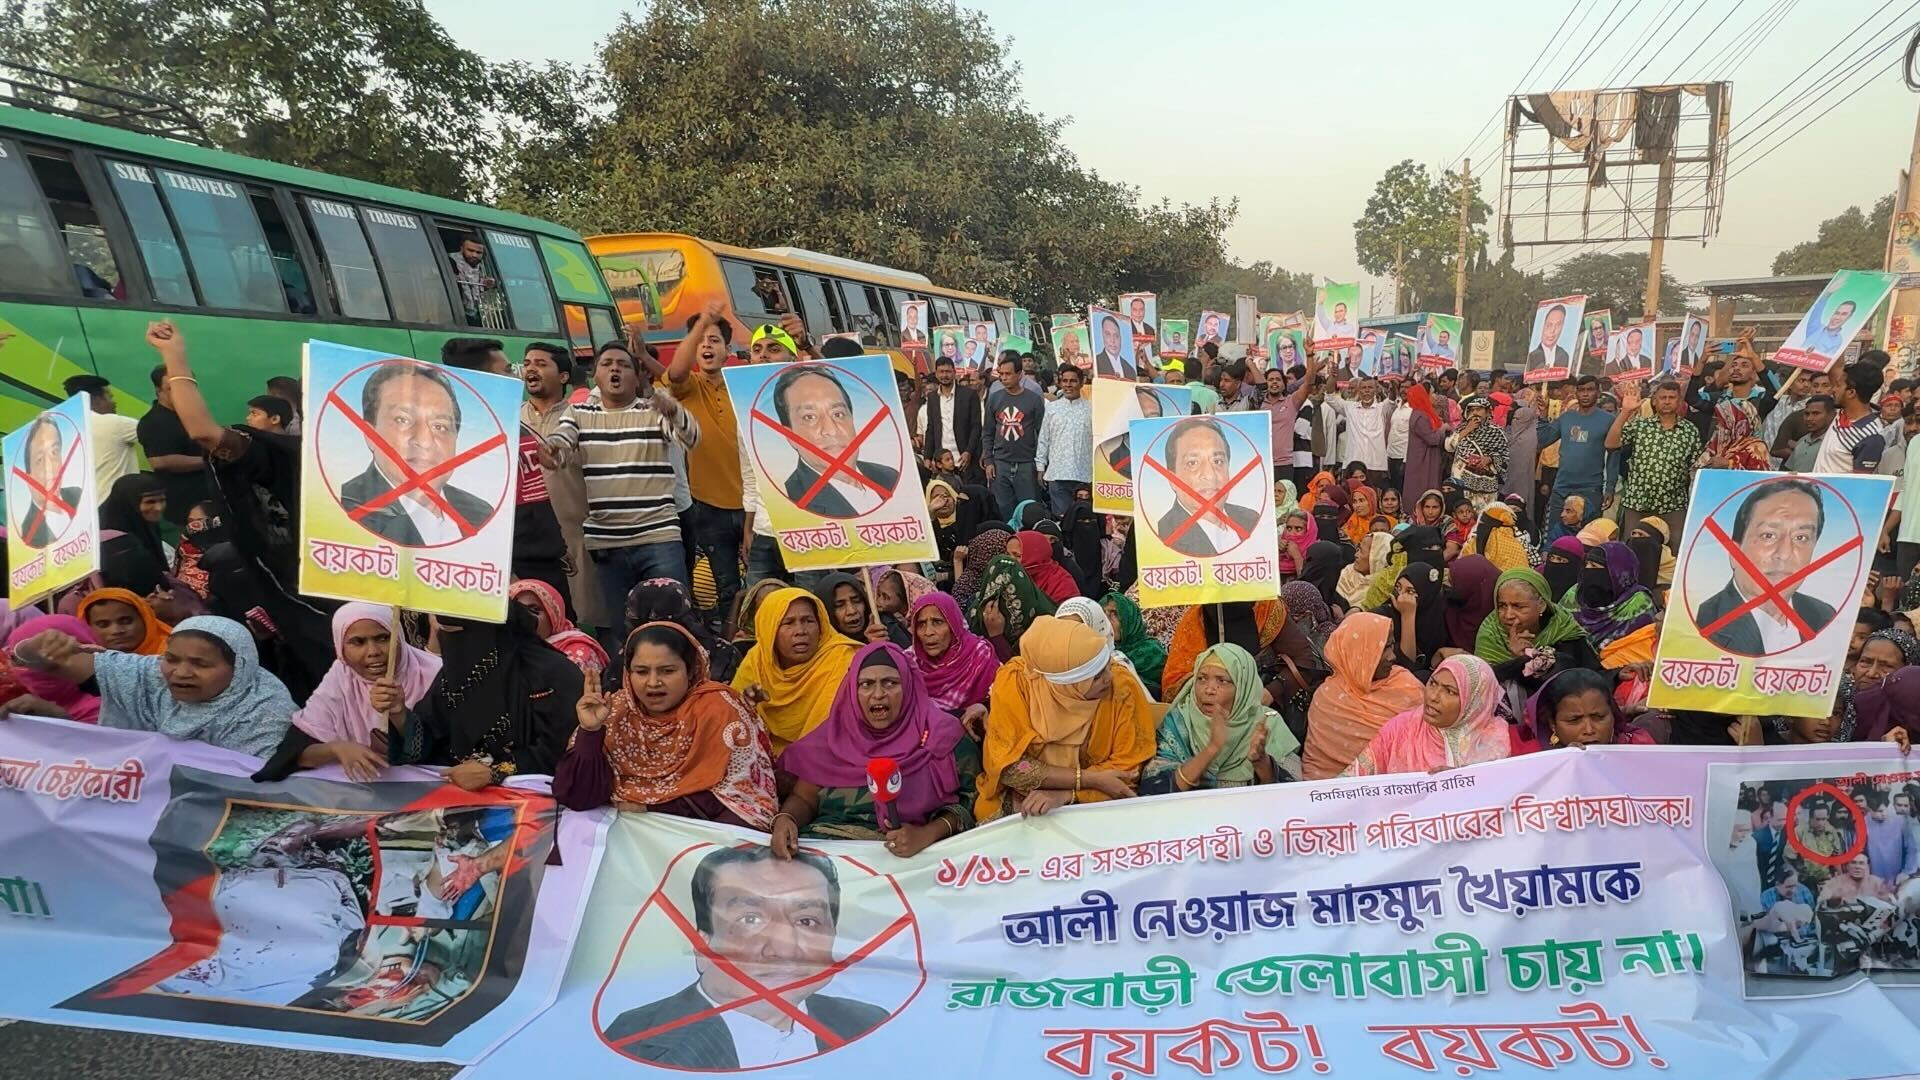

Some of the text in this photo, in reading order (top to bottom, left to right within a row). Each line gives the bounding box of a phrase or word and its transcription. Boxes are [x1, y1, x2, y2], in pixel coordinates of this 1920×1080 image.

[165, 172, 238, 199] TRAVELS
[366, 208, 417, 230] TRAVELS
[492, 232, 531, 249] TRAVELS
[52, 530, 91, 566] বয়কট!
[780, 516, 925, 551] বয়কট! বয়কট!
[311, 541, 502, 594] বয়কট! বয়কট!
[1142, 557, 1272, 589] বয়কট! বয়কট!
[1661, 657, 1832, 694] বয়কট! বয়কট!
[37, 758, 146, 800] চেষ্টাকারী
[1309, 774, 1476, 803] বিসমিল্লাহির রাহমানির রাহিম
[1041, 854, 1085, 880] এর
[1090, 826, 1243, 873] সংস্কারপন্থী
[1252, 828, 1275, 856] ও
[1282, 818, 1358, 857] জিয়া
[1366, 807, 1505, 850] পরিবারের
[1510, 794, 1692, 833] বিশ্বাসঘাতক!
[1002, 861, 1642, 945] আলী নেওয়াজ মাহমুদ খৈয়ামকে
[946, 929, 1706, 1014] রাজবাড়ী জেলাবাসী চায় না।
[1042, 1001, 1668, 1080] বয়কট! বয়কট!
